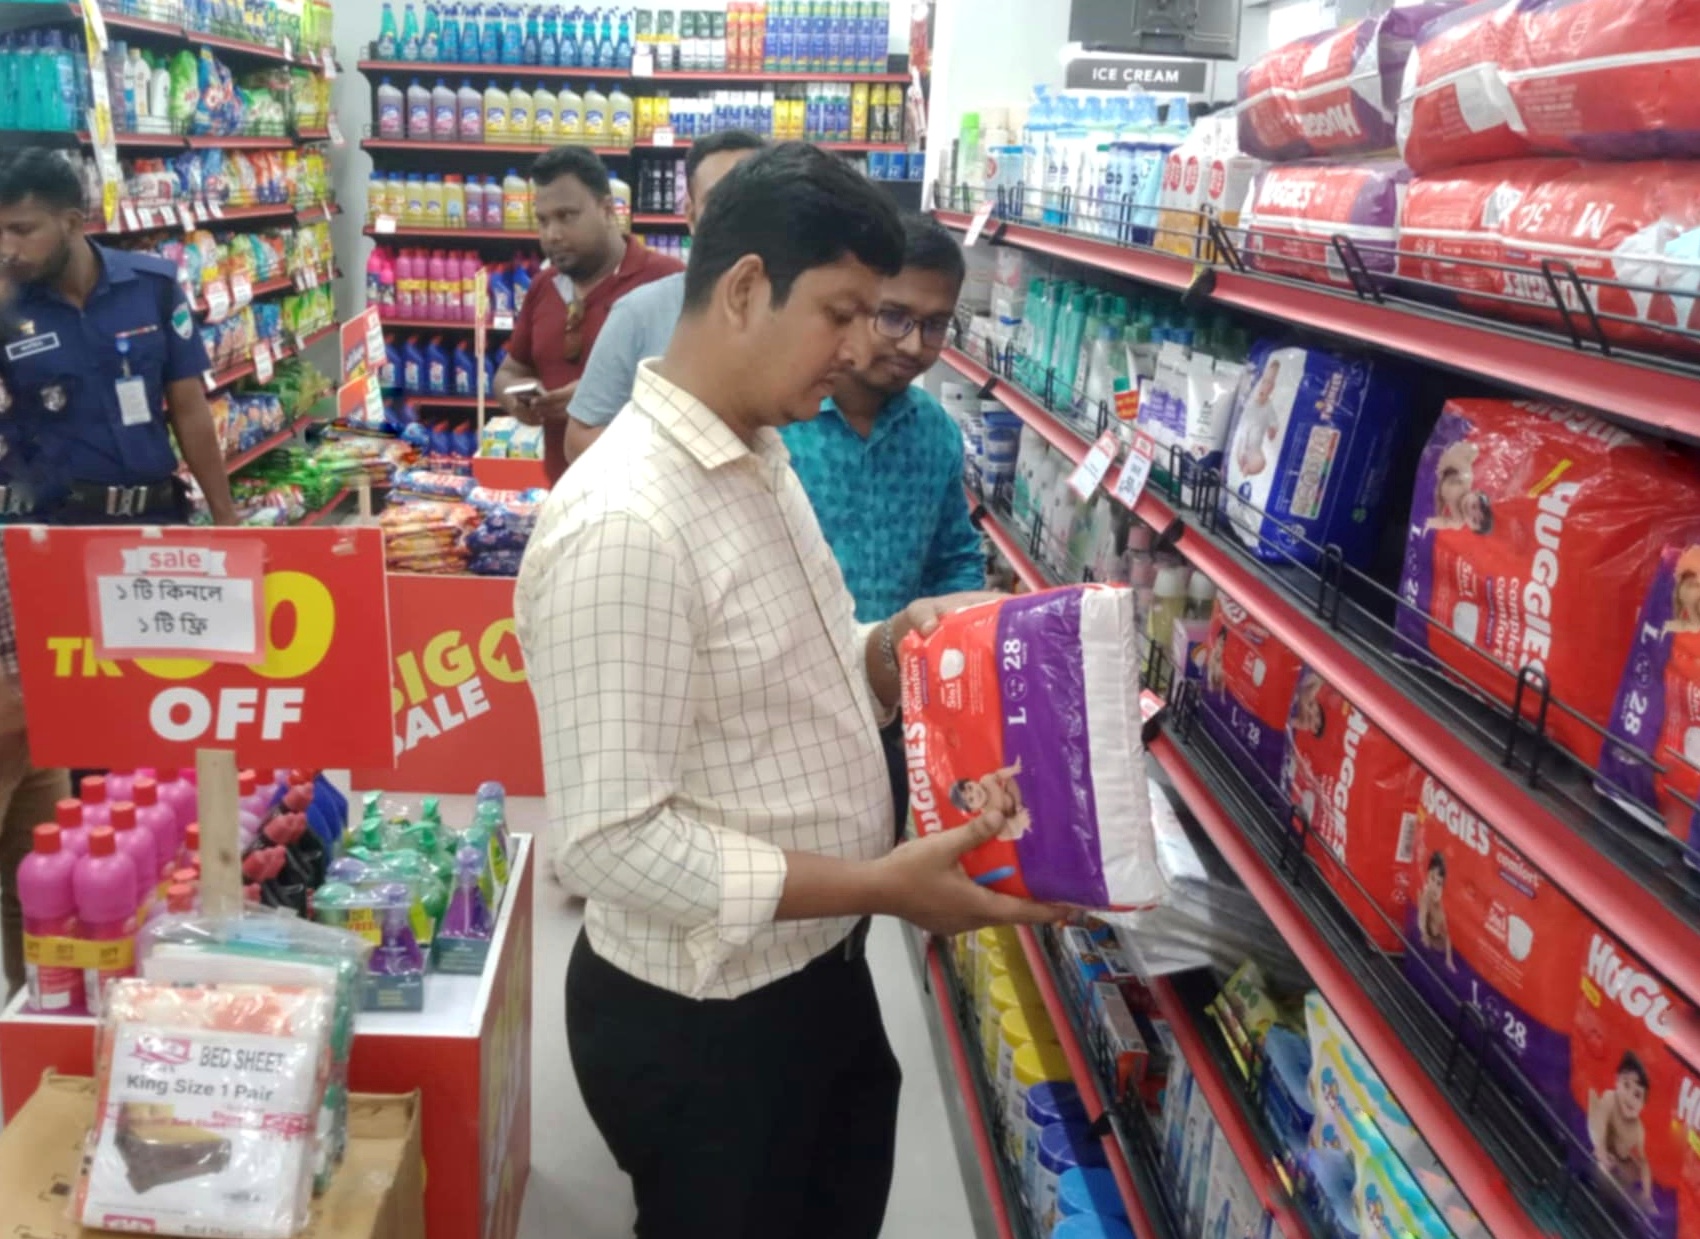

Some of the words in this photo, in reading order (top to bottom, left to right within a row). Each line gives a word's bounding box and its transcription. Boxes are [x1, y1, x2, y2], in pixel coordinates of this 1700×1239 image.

[1092, 67, 1117, 81] ICE
[1122, 68, 1179, 83] CREAM
[149, 549, 202, 569] sale
[116, 584, 128, 600] ১
[132, 578, 154, 601] টি
[159, 579, 223, 602] কিনলে
[132, 570, 336, 680] 0
[138, 617, 149, 633] ১
[153, 610, 175, 633] টি
[179, 611, 210, 636] ফ্রি
[1003, 638, 1022, 671] 28
[393, 630, 477, 715] IG
[149, 686, 305, 742] OFF
[1008, 706, 1027, 726] L
[1623, 684, 1648, 735] 28
[901, 721, 944, 834] UGGIES
[1503, 1011, 1527, 1049] 28
[200, 1045, 231, 1069] BED
[234, 1049, 286, 1073] SHEET
[127, 1074, 169, 1095] King
[174, 1079, 215, 1096] Size
[222, 1084, 229, 1097] 1
[234, 1085, 274, 1101] Pair
